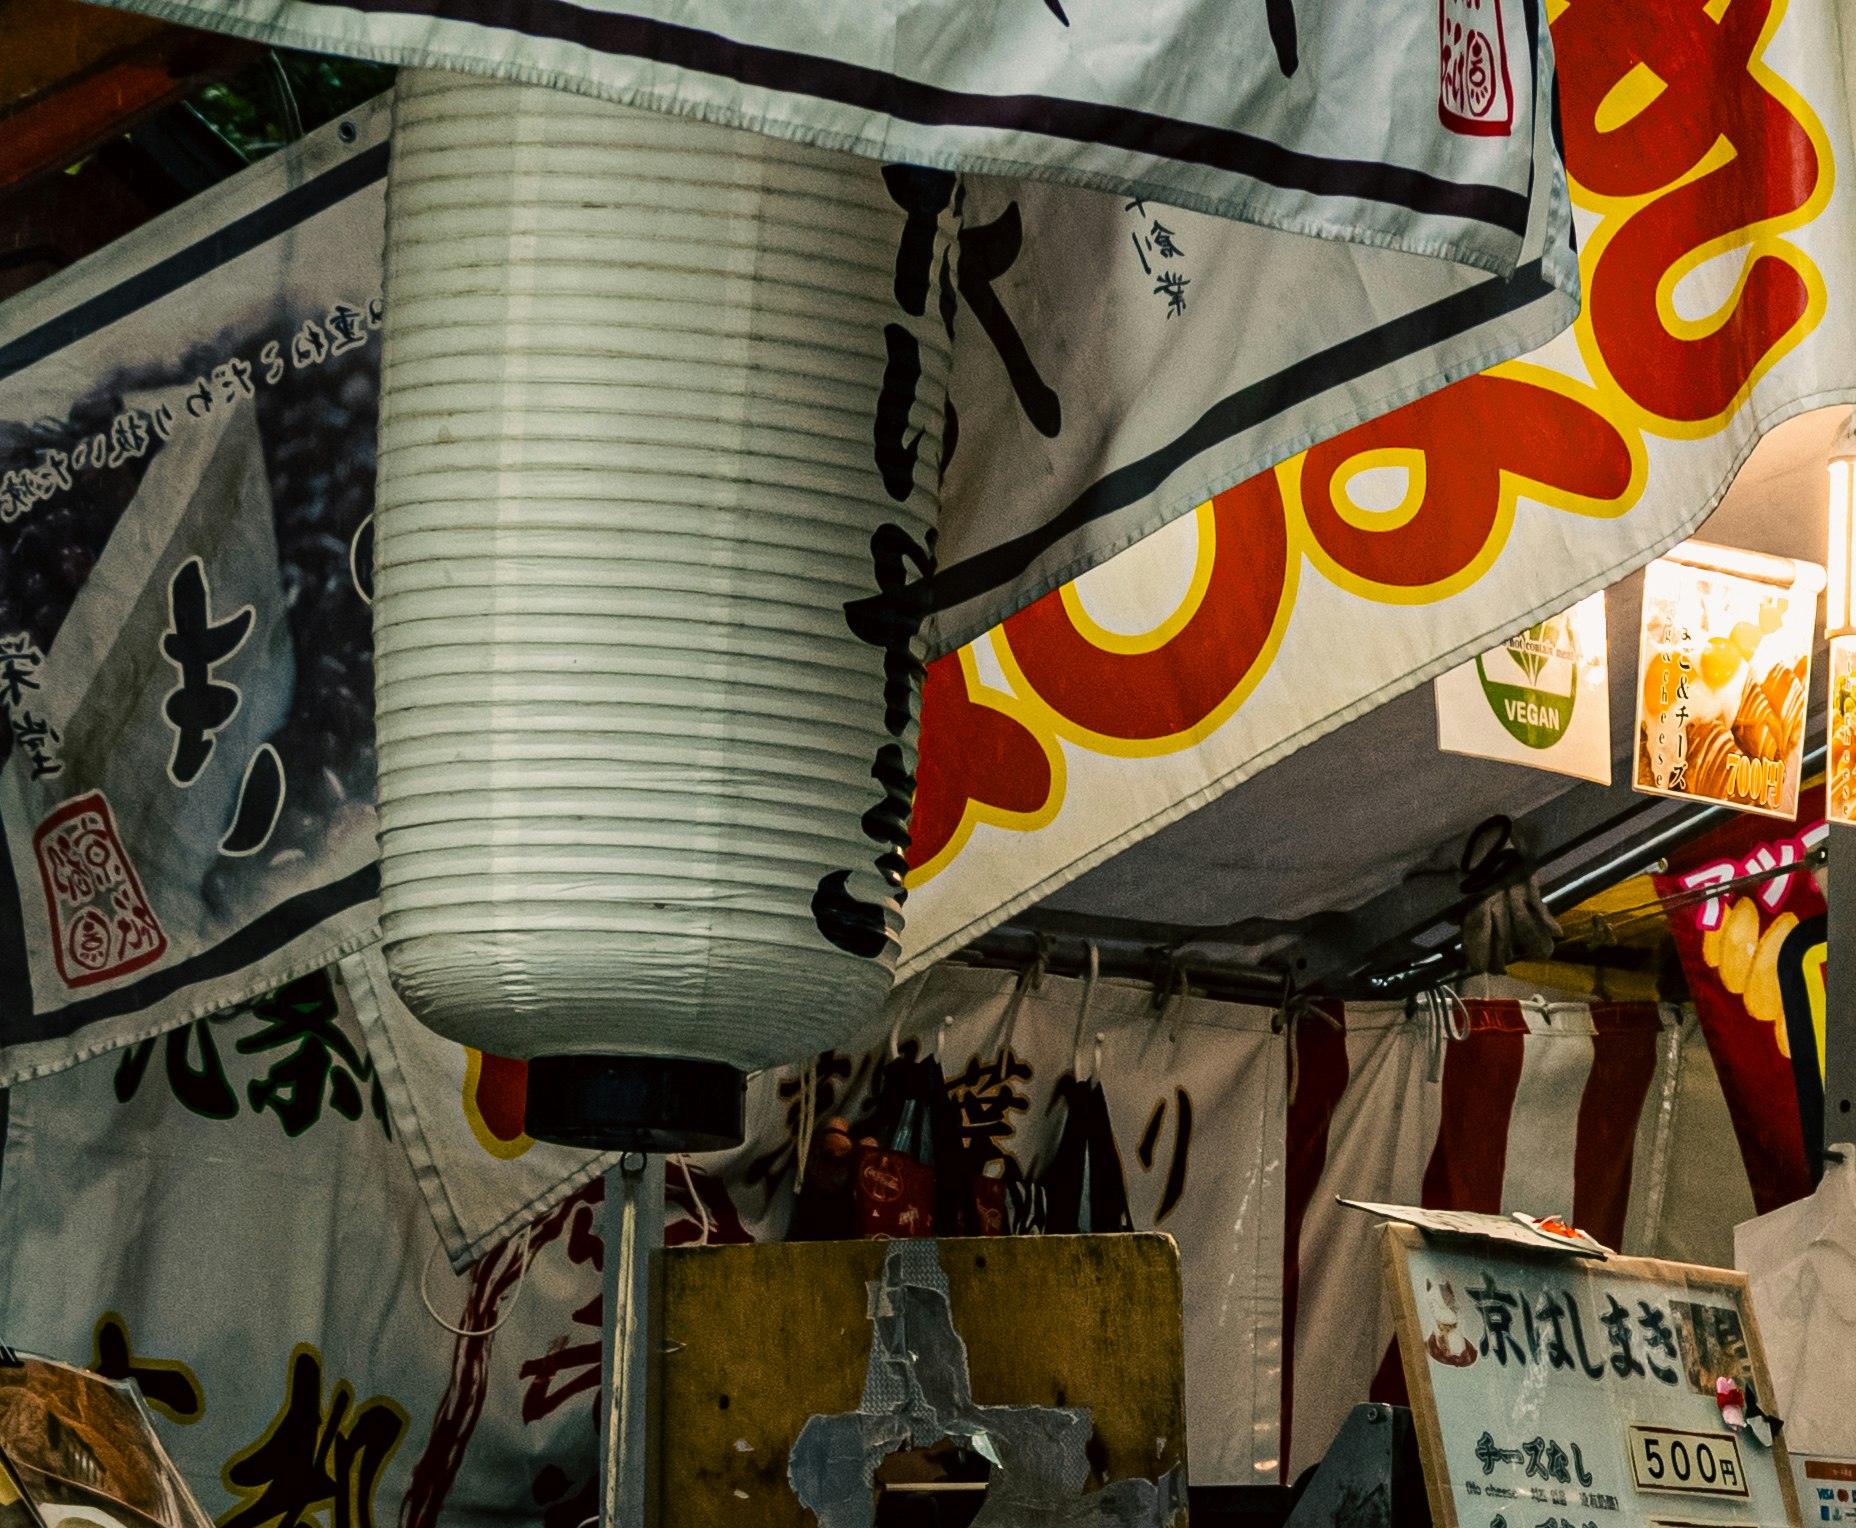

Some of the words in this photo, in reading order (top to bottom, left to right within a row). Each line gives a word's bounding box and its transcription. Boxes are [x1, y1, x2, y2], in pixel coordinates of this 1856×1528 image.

[1503, 698, 1561, 731] VEGAN
[1726, 753, 1786, 809] 700円
[1465, 1270, 1679, 1386] 京はしまき
[1474, 1431, 1593, 1488] チーズなし
[1645, 1437, 1738, 1488] 500円
